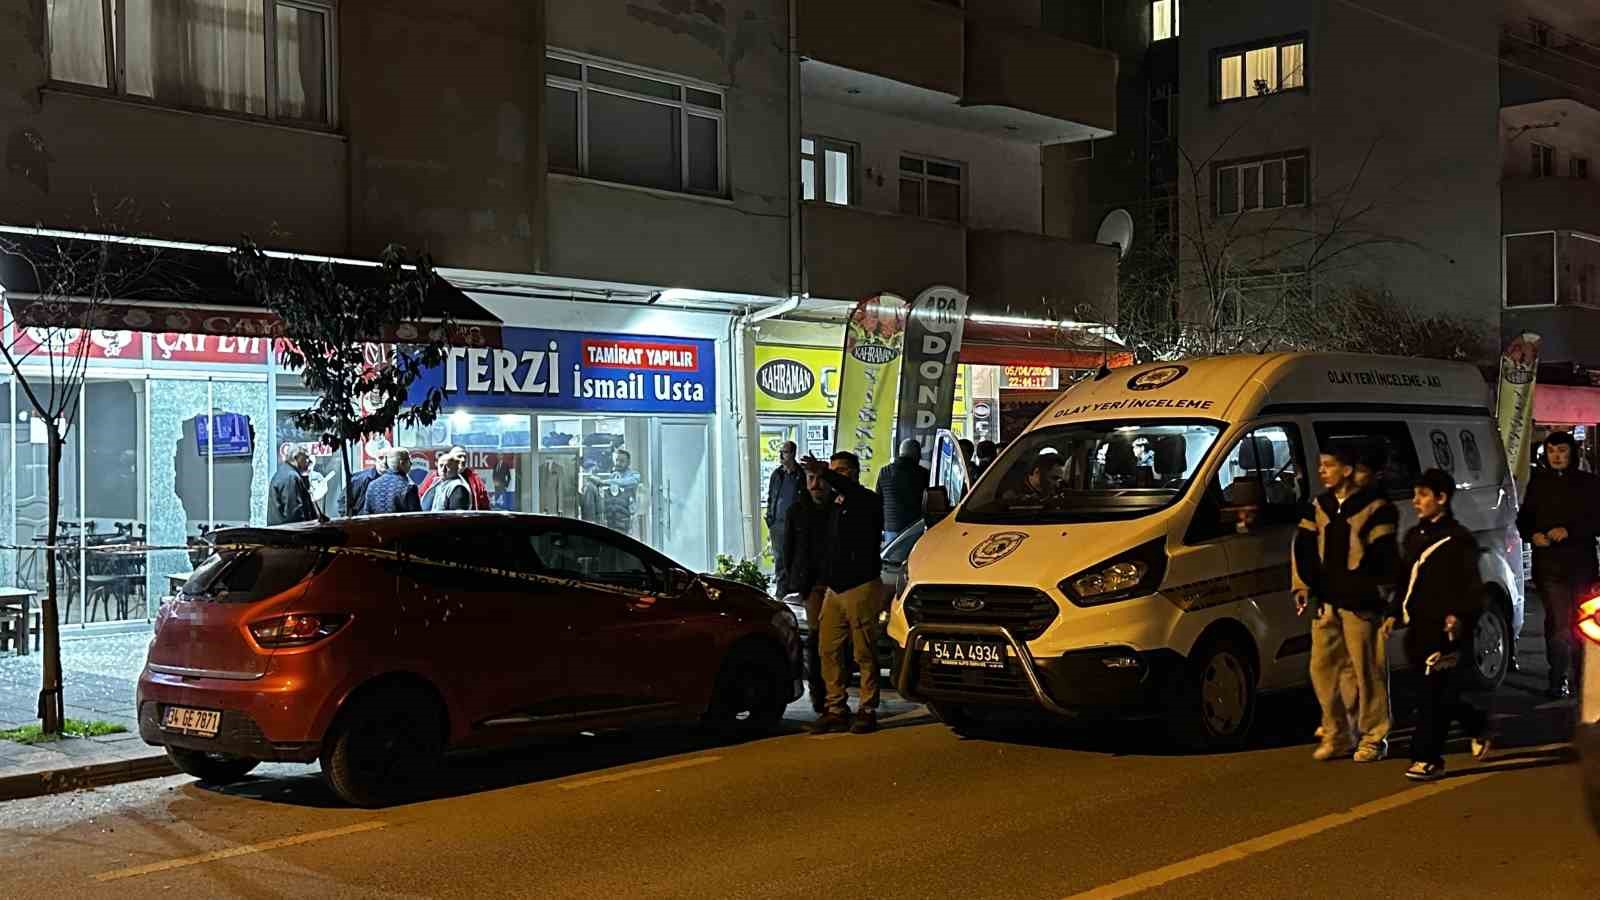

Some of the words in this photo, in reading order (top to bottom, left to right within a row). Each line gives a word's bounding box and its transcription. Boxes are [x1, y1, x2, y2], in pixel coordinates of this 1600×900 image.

[587, 343, 643, 365] TAMİRAT
[645, 349, 693, 368] YAPILIR
[854, 345, 895, 362] KAHRAMAN
[442, 340, 561, 394] TERZİ
[573, 363, 644, 399] İsmail
[654, 374, 704, 401] Usta
[761, 363, 812, 395] KAHRAMAN
[1053, 405, 1092, 418] OLAY
[1092, 399, 1128, 412] YERİ
[1127, 399, 1215, 410] İNCELEME
[934, 643, 950, 659] 54
[954, 643, 965, 660] A
[968, 645, 999, 662] 4934
[168, 708, 179, 725] 34
[182, 709, 194, 727] GE
[195, 711, 218, 730] 7871
